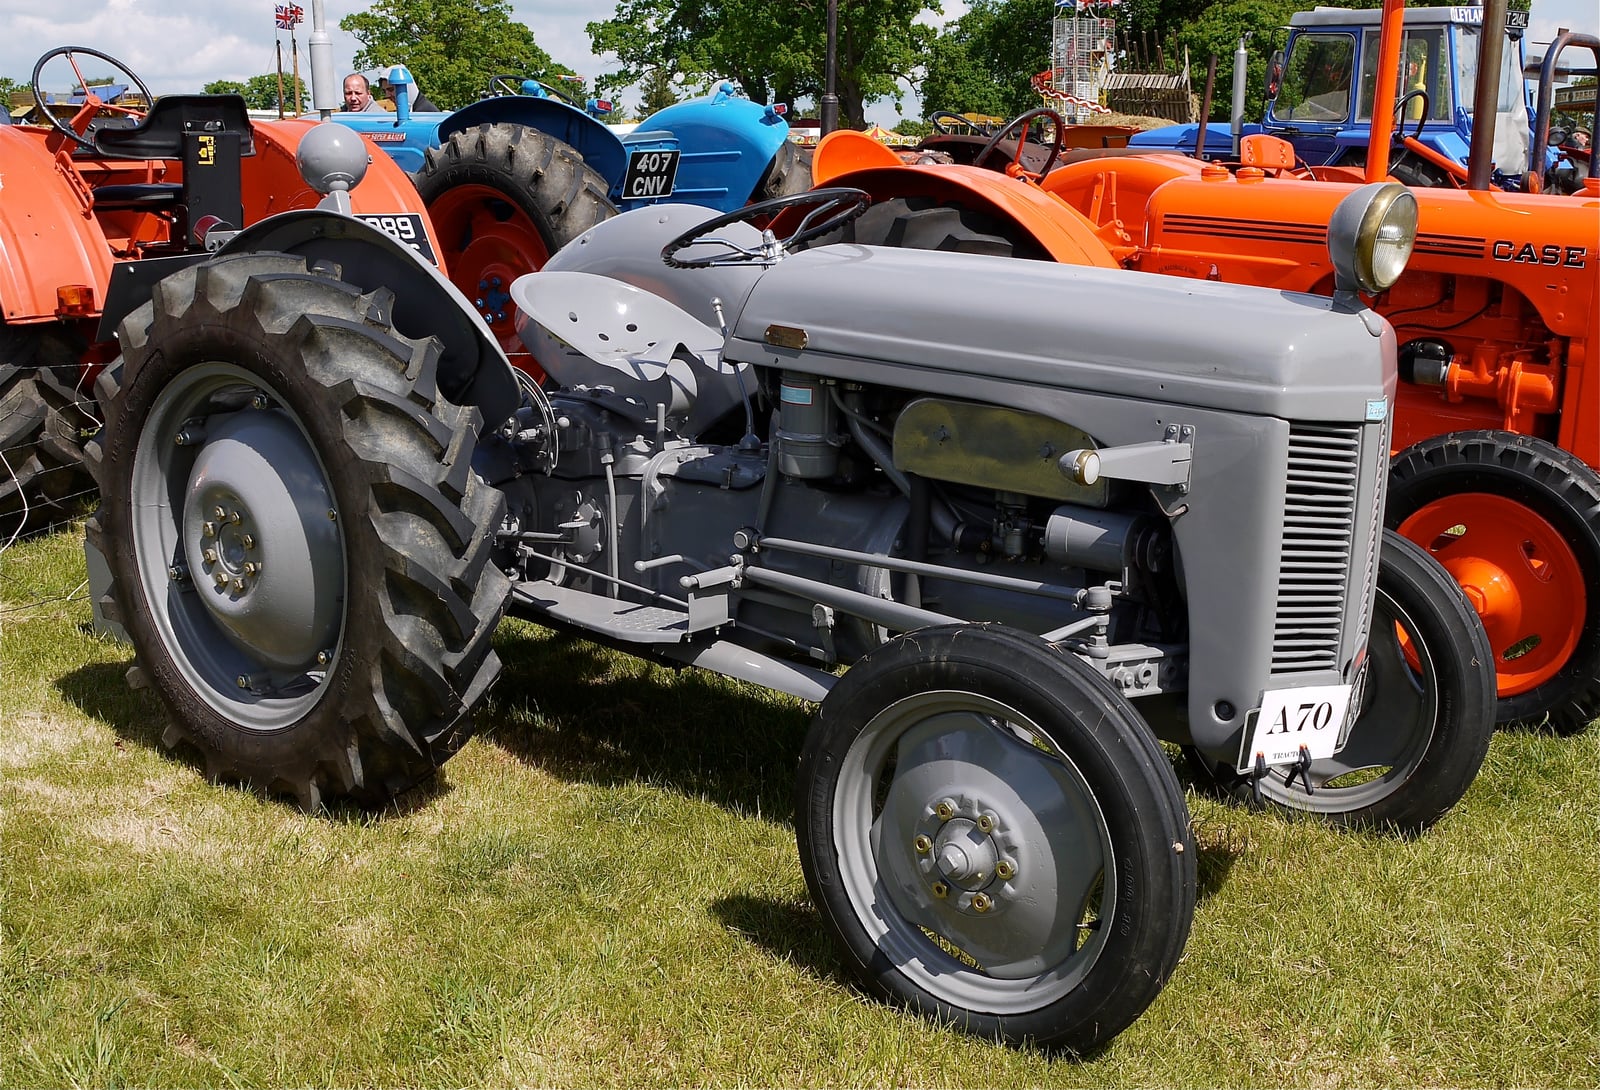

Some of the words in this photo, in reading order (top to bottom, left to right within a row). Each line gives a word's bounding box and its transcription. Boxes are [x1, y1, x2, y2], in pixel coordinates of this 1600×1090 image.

[1456, 8, 1483, 22] LEYLAN
[636, 153, 672, 172] 407
[632, 175, 667, 195] CNV
[1492, 240, 1587, 269] CASE
[1265, 704, 1290, 735] A
[1296, 701, 1333, 732] 70
[1273, 750, 1301, 760] TRACTO
